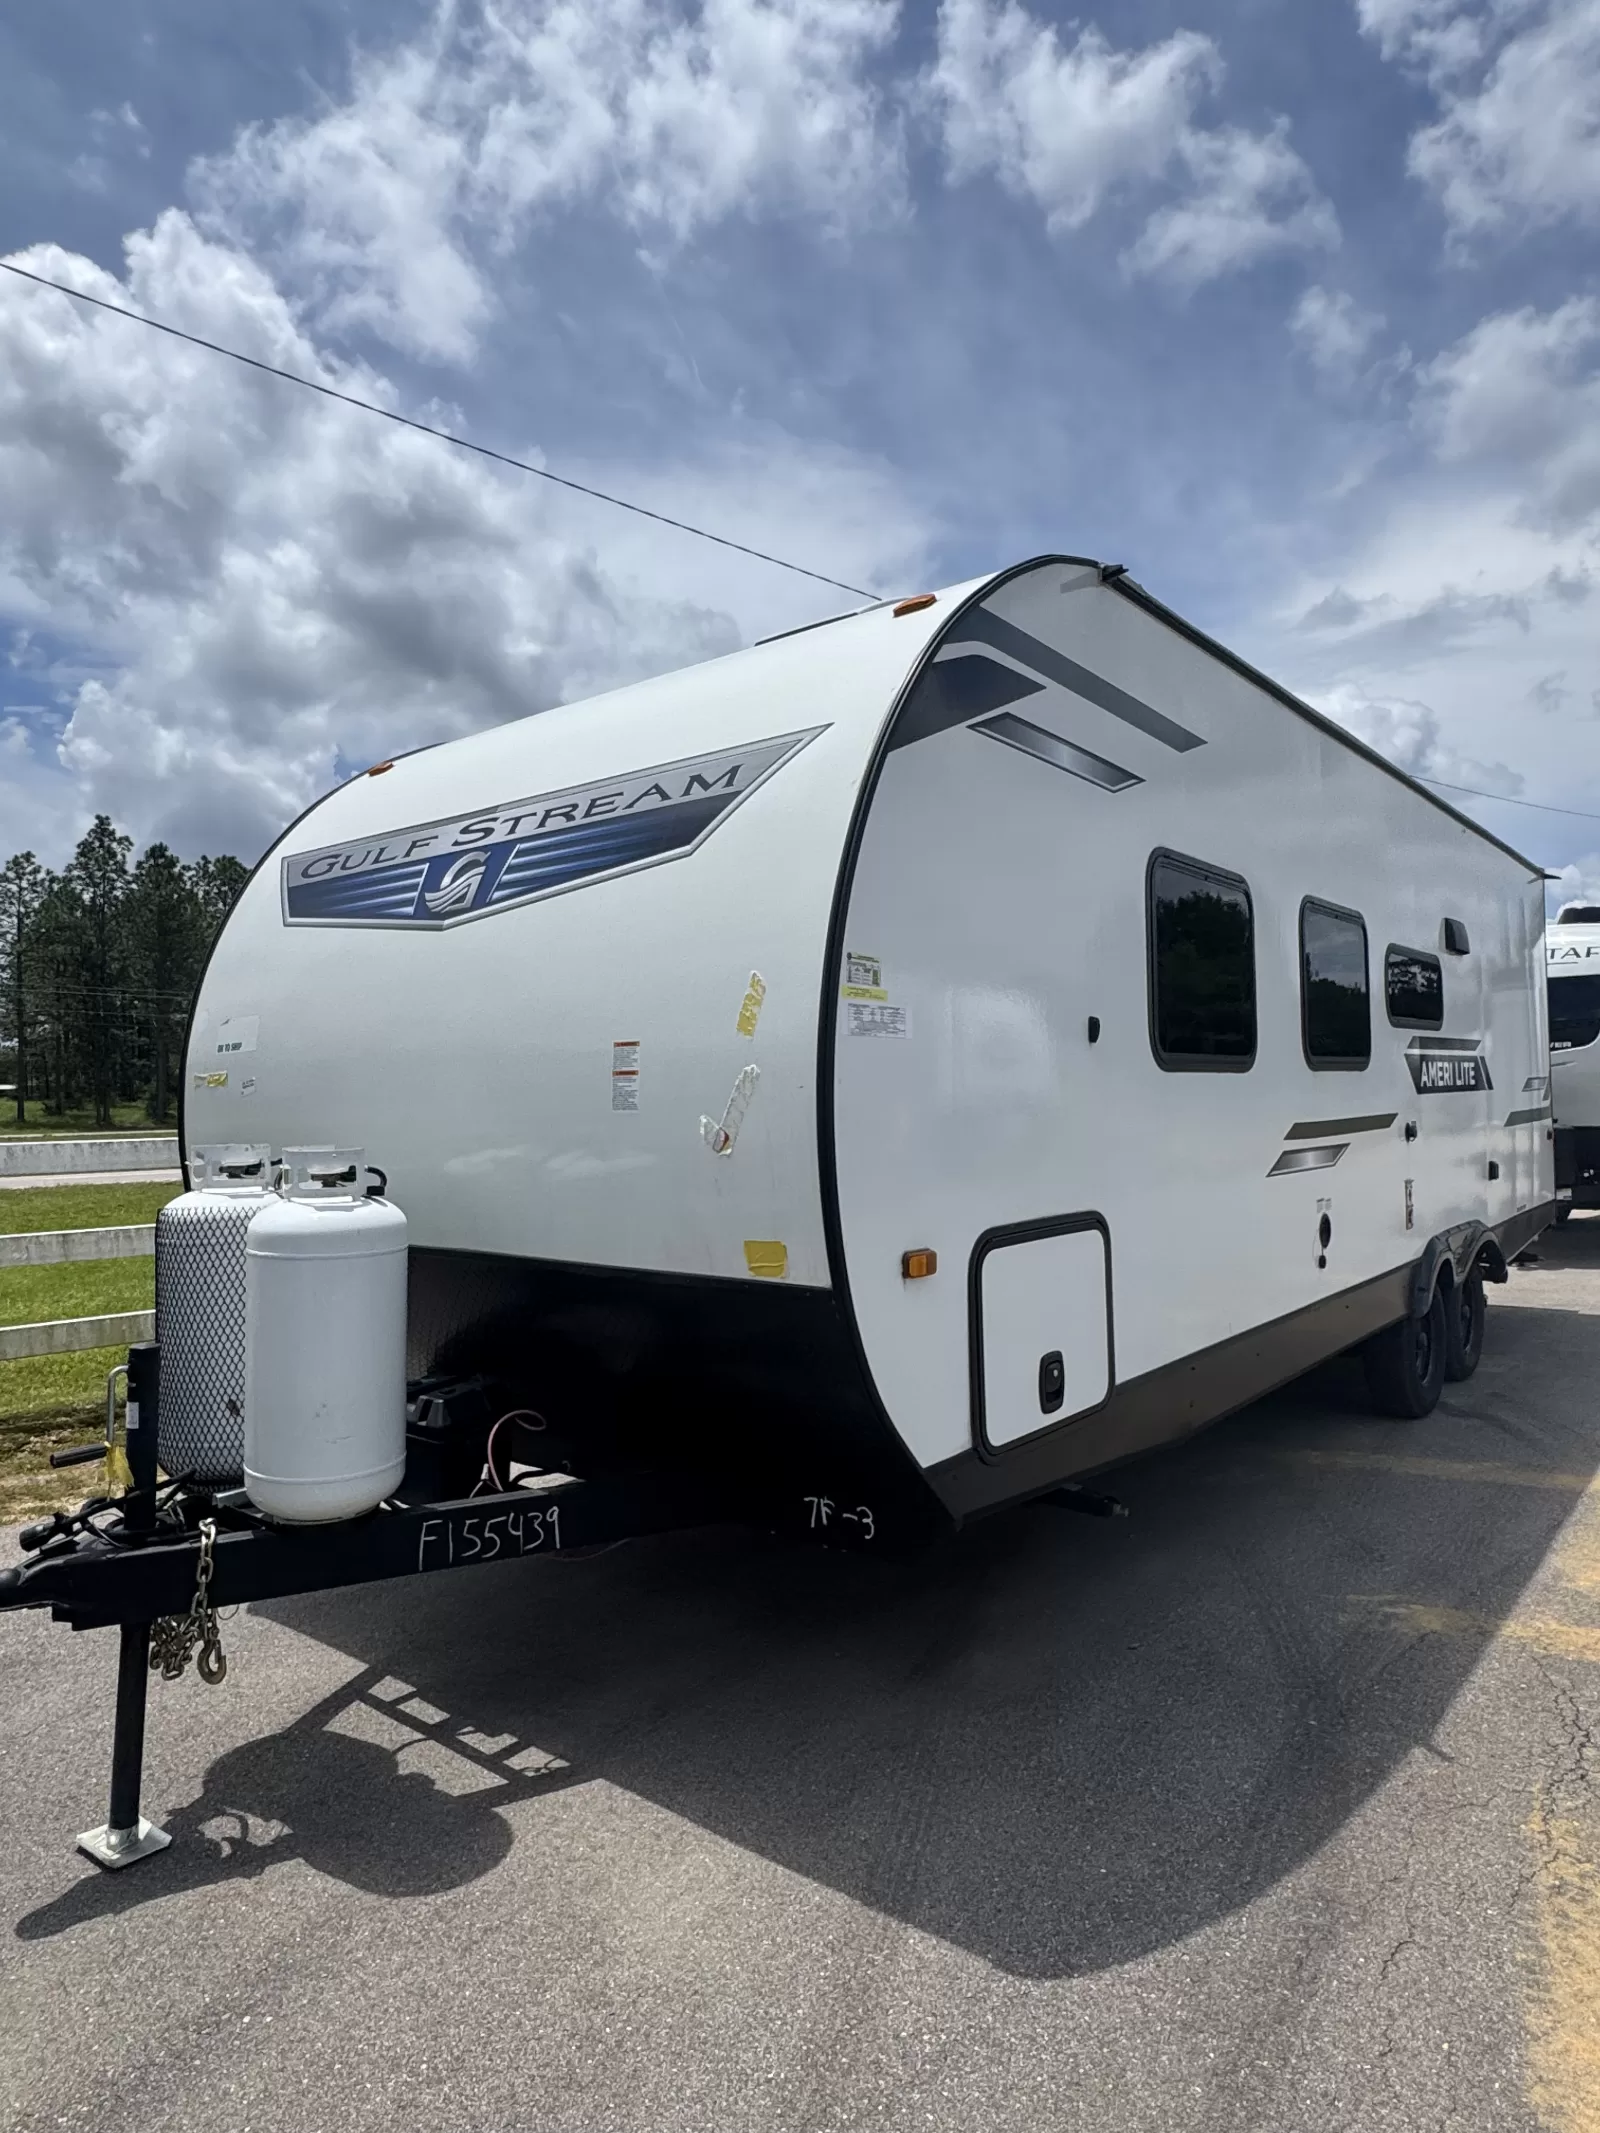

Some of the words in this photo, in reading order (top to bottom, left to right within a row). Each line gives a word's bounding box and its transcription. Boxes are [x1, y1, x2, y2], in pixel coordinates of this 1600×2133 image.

[300, 835, 439, 879] GULF
[451, 763, 745, 847] STREAM
[1420, 1061, 1454, 1087] AMERI
[1454, 1061, 1477, 1086] LITE
[418, 1505, 561, 1572] F155439
